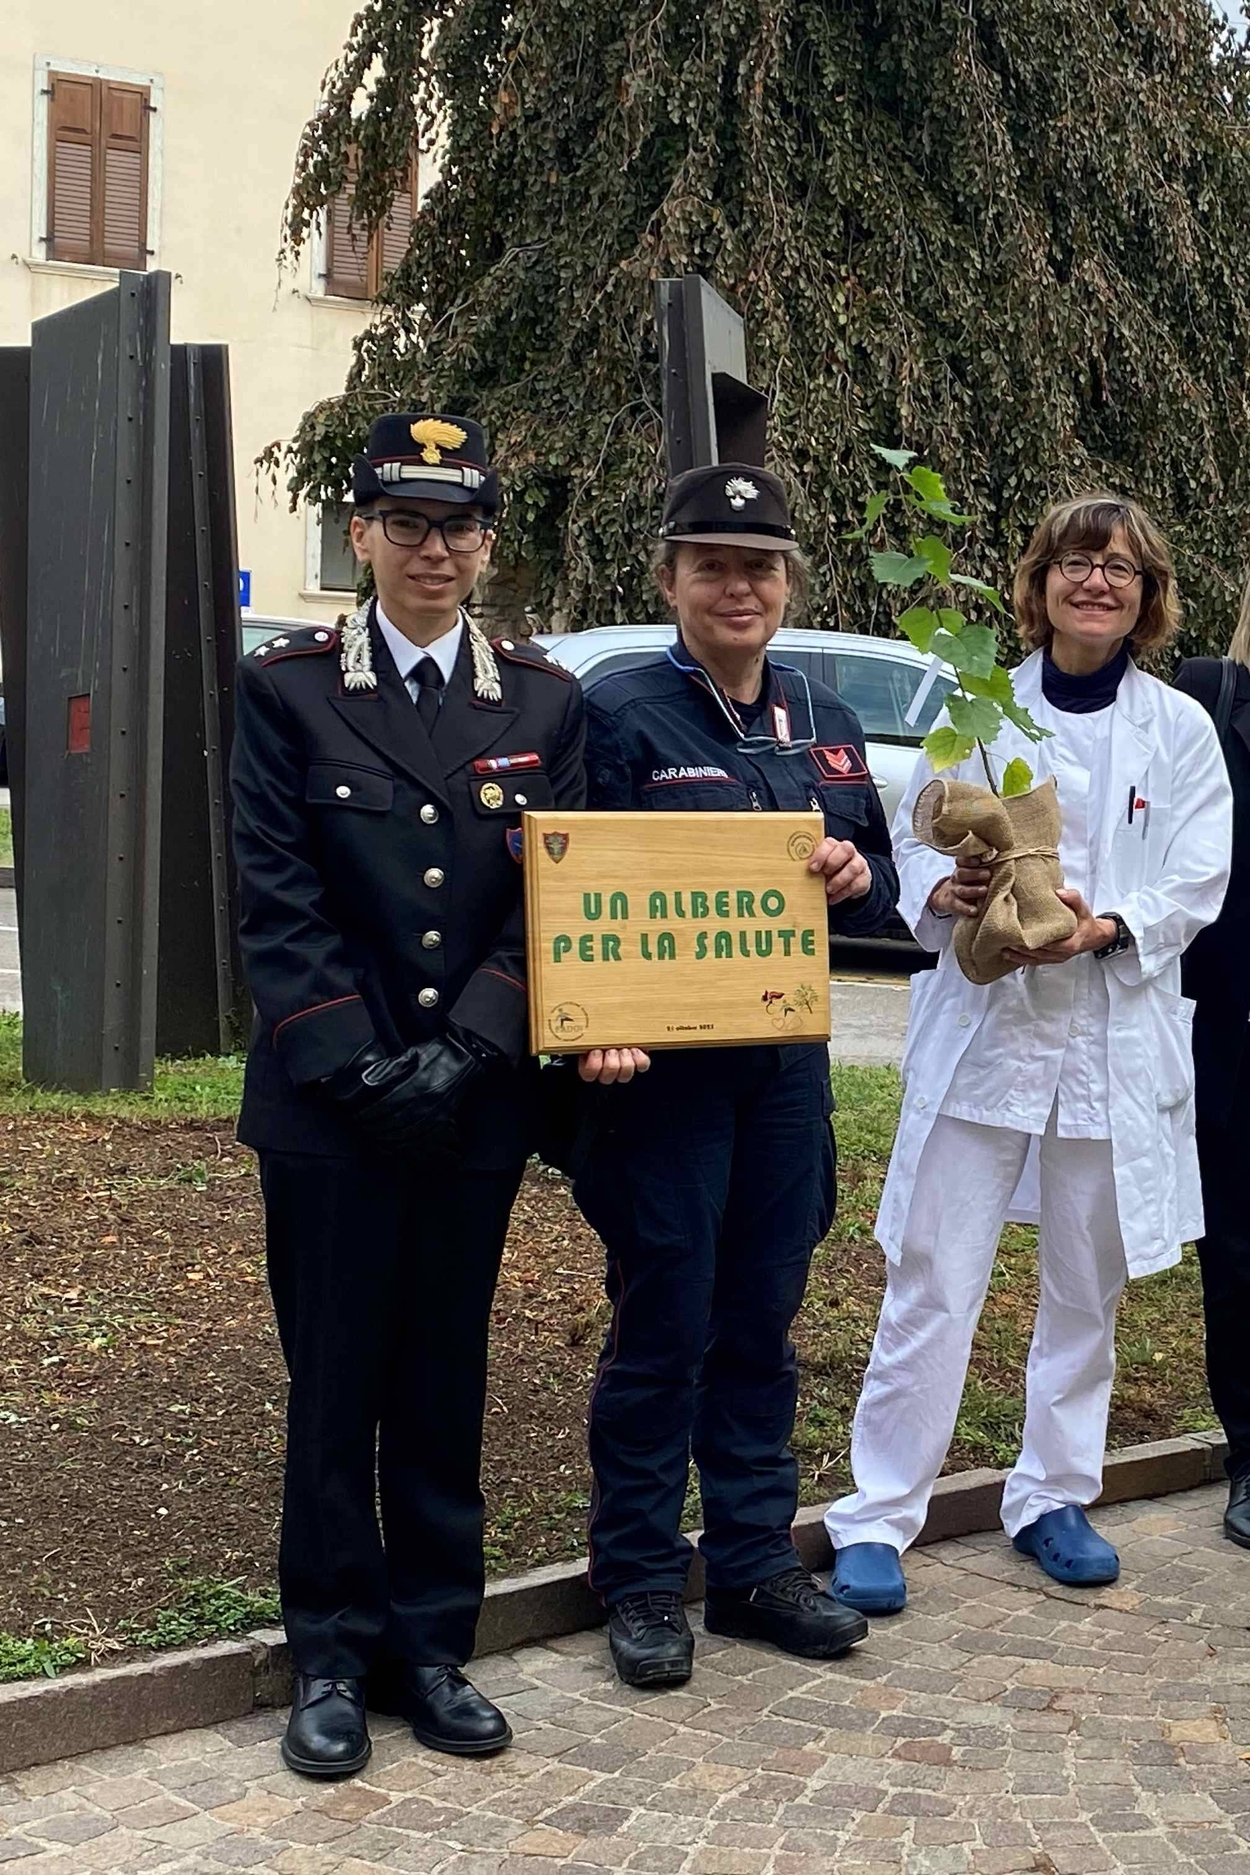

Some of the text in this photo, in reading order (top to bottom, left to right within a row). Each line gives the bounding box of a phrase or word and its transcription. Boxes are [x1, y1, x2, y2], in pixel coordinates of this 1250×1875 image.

[582, 889, 786, 921] UN ALBERO
[552, 929, 815, 963] PER LA SALUTE
